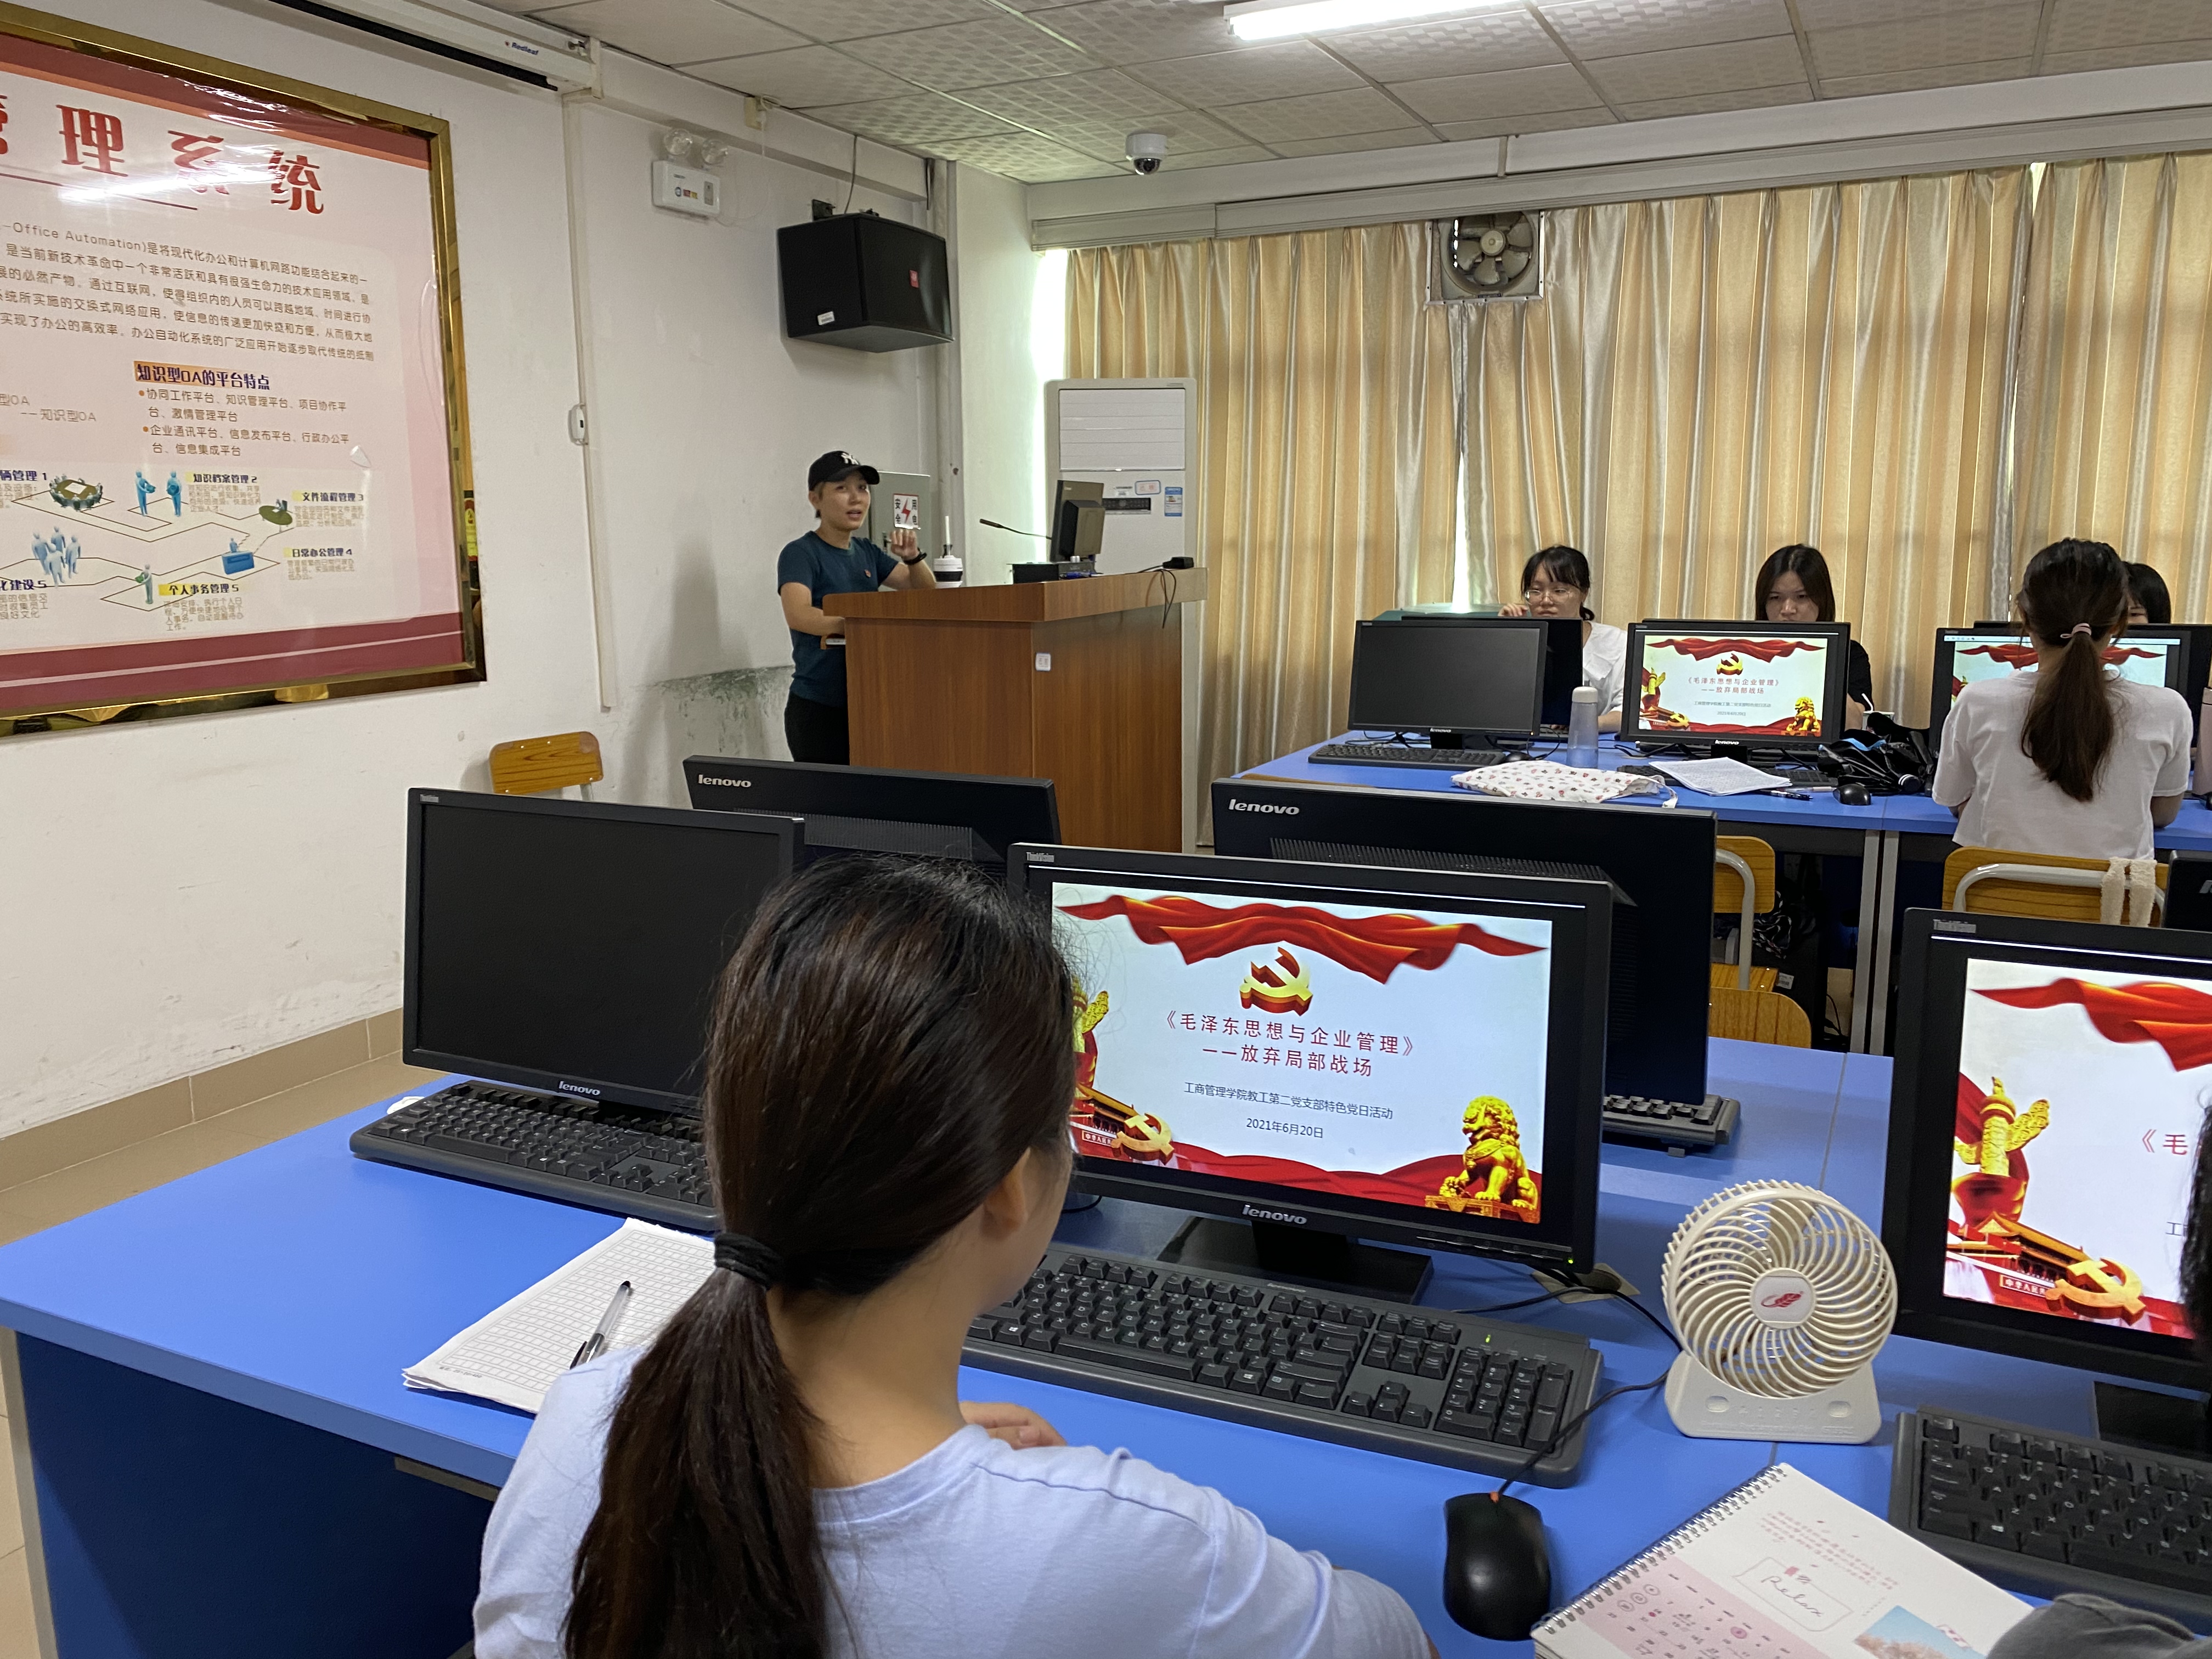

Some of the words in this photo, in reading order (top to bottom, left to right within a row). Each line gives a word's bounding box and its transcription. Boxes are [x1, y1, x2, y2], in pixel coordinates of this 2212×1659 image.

[0, 94, 324, 215] 理系统
[138, 364, 270, 390] 知识型OA的平台特点
[152, 442, 241, 456] 台、信息集成平台
[42, 472, 47, 481] 1
[169, 584, 229, 595] 个人事务管理
[1688, 677, 1779, 686] 《毛泽东思想与企业管理》
[698, 774, 752, 788] lenovo
[1228, 799, 1300, 815] lenovo
[1166, 1010, 1414, 1056] 《毛泽东思想与企业管理》
[558, 1080, 601, 1096] lenovo
[1184, 1082, 1393, 1120] 工商管理学院教工第二党支部特色党日活动
[1246, 1118, 1324, 1139] 2021年6月20日
[2142, 1128, 2189, 1155] 《毛
[1242, 1204, 1307, 1224] lenovo
[2165, 1221, 2189, 1237] 工
